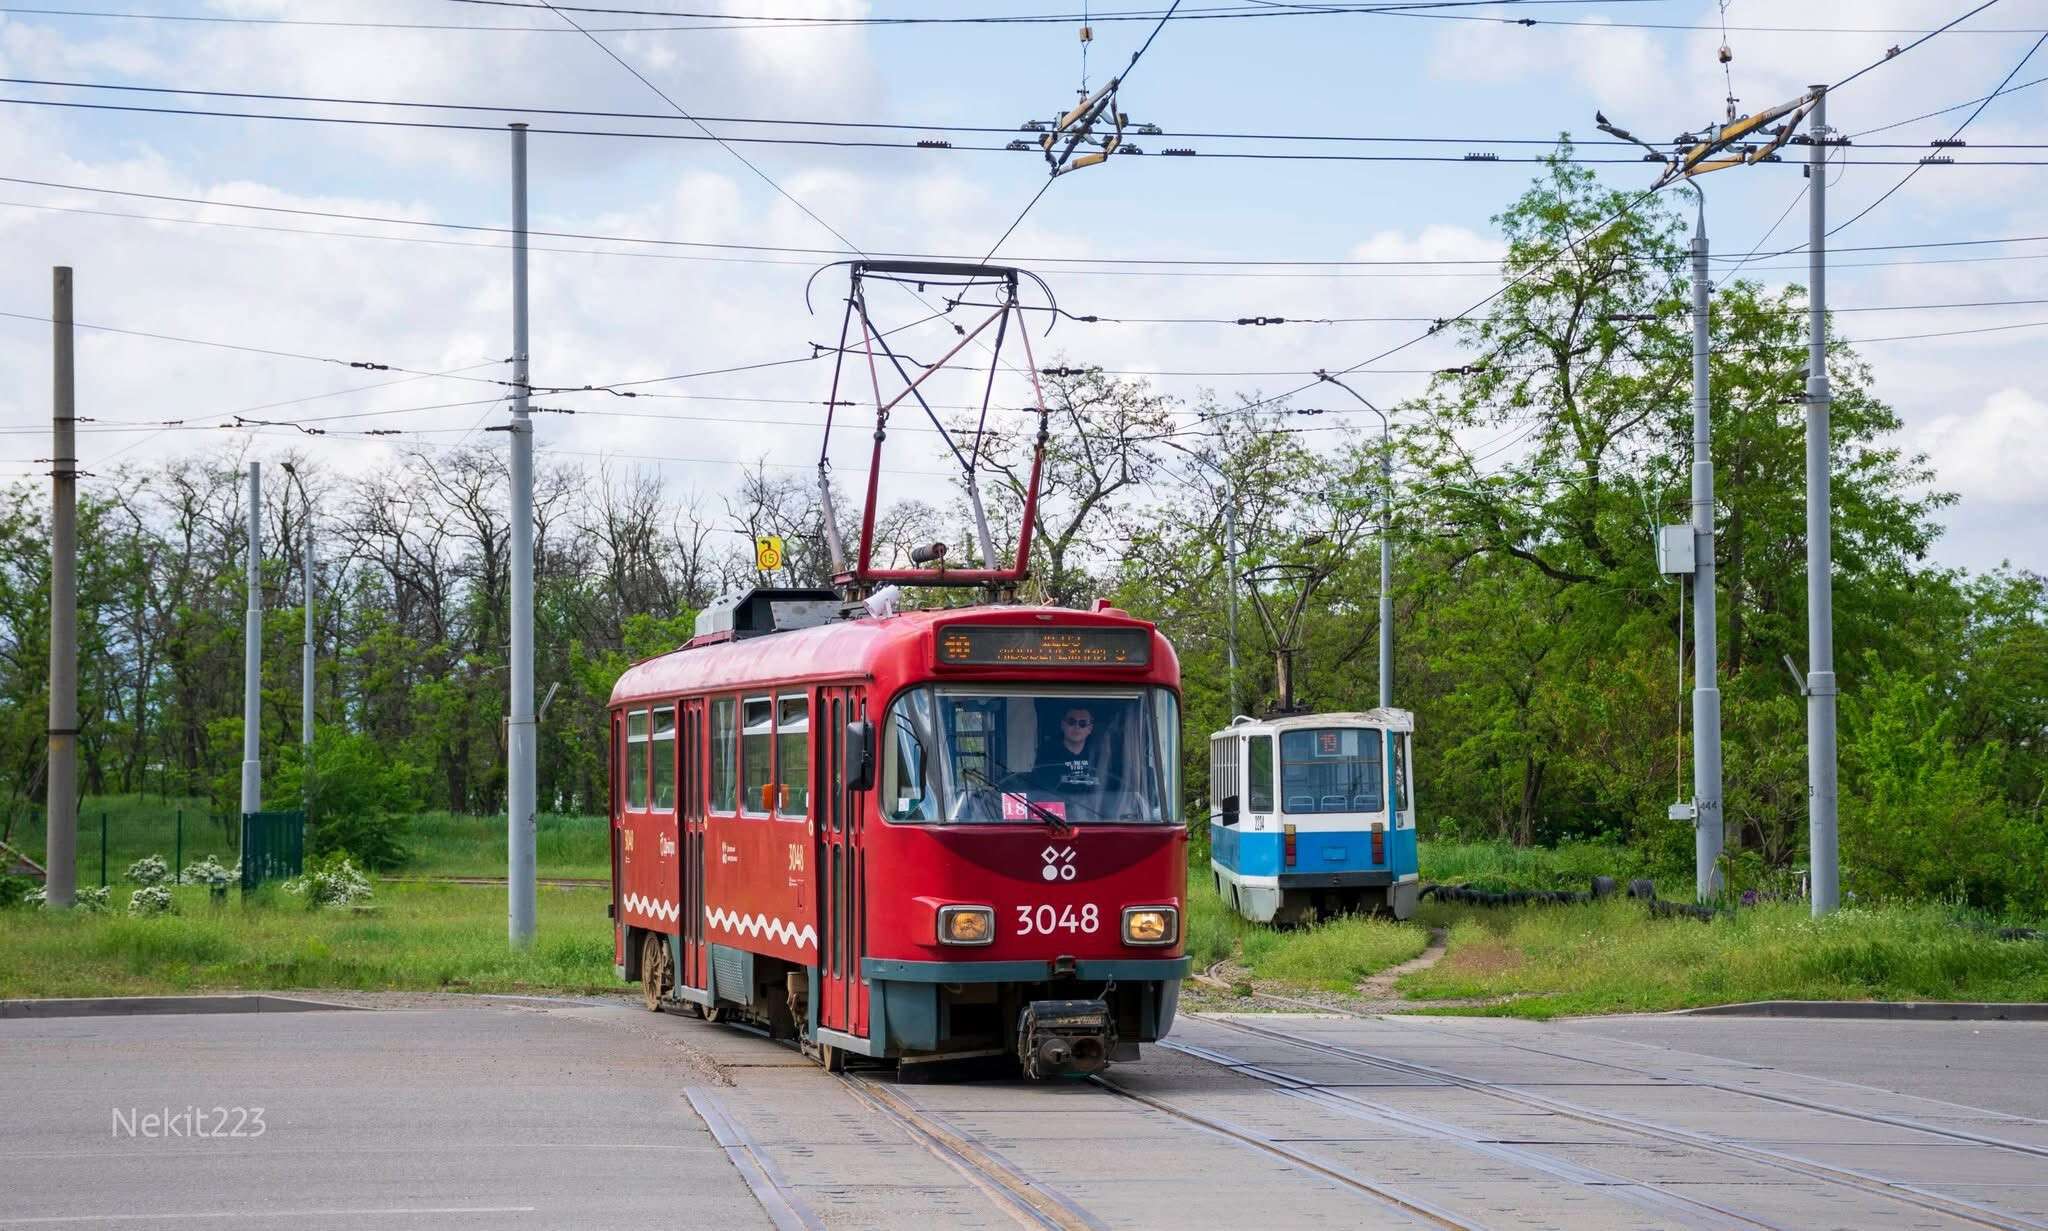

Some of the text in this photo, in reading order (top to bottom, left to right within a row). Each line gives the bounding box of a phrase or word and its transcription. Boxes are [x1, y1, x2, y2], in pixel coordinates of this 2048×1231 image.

[763, 553, 775, 563] 15
[1005, 801, 1025, 816] 18
[1016, 903, 1099, 936] 3048
